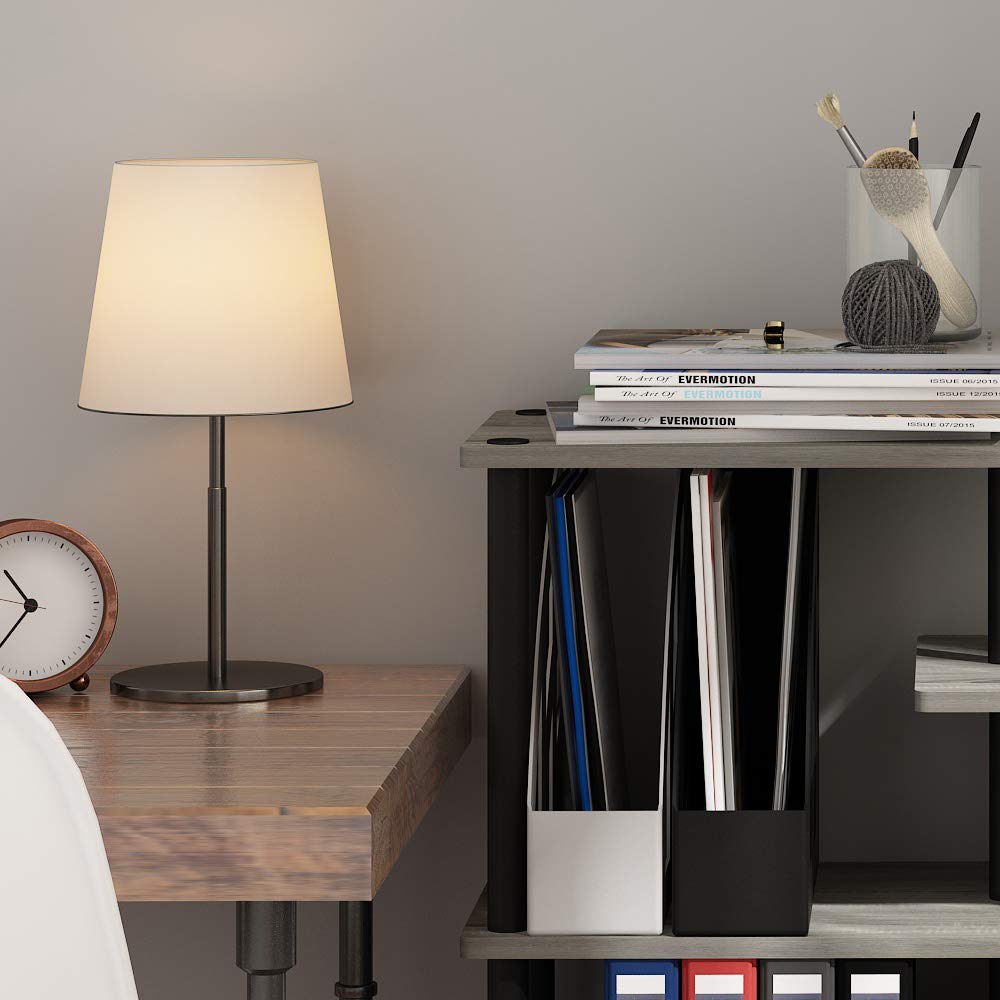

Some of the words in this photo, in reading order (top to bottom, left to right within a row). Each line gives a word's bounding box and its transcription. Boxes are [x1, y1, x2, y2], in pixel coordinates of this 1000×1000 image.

[616, 374, 635, 382] The
[636, 374, 653, 382] Art
[654, 375, 673, 383] Of
[678, 375, 756, 385] EVERMOTION
[621, 390, 640, 398] The
[641, 390, 659, 398] Art
[660, 390, 678, 399] Of
[684, 389, 762, 399] EVERMOTION
[599, 415, 617, 423] The
[637, 416, 655, 424] Of
[660, 416, 736, 426] EVERMOTION
